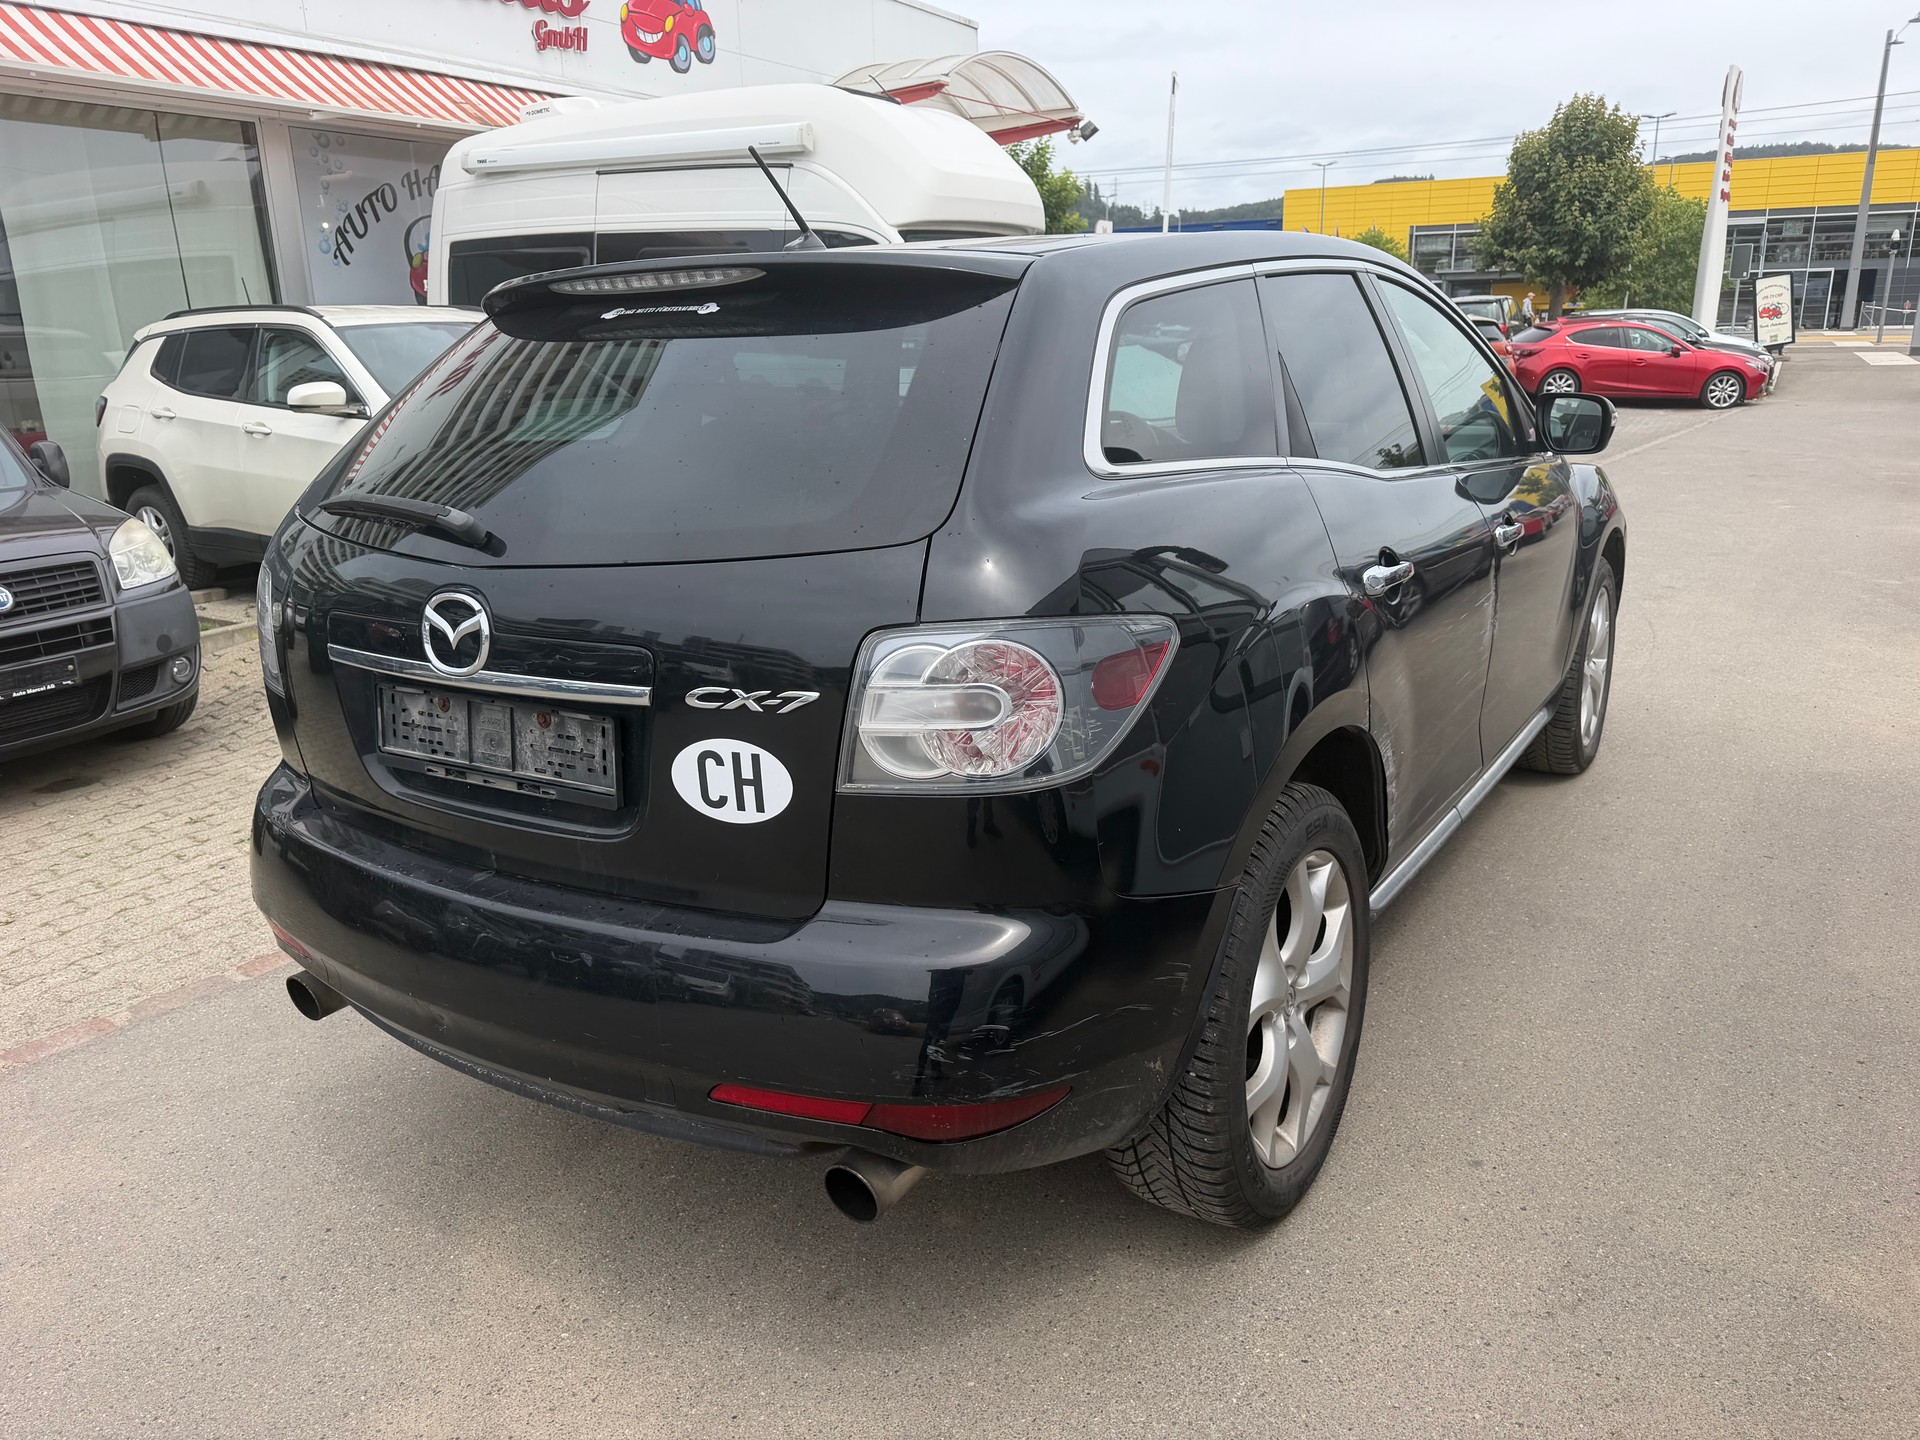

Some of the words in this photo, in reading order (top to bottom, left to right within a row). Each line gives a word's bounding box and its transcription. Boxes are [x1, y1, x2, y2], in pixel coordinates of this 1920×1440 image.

[533, 19, 588, 52] GmbH
[333, 182, 398, 266] AUTO
[12, 690, 27, 698] Auto
[26, 685, 47, 694] Marcel
[684, 686, 821, 714] CX-7
[696, 750, 766, 813] CH
